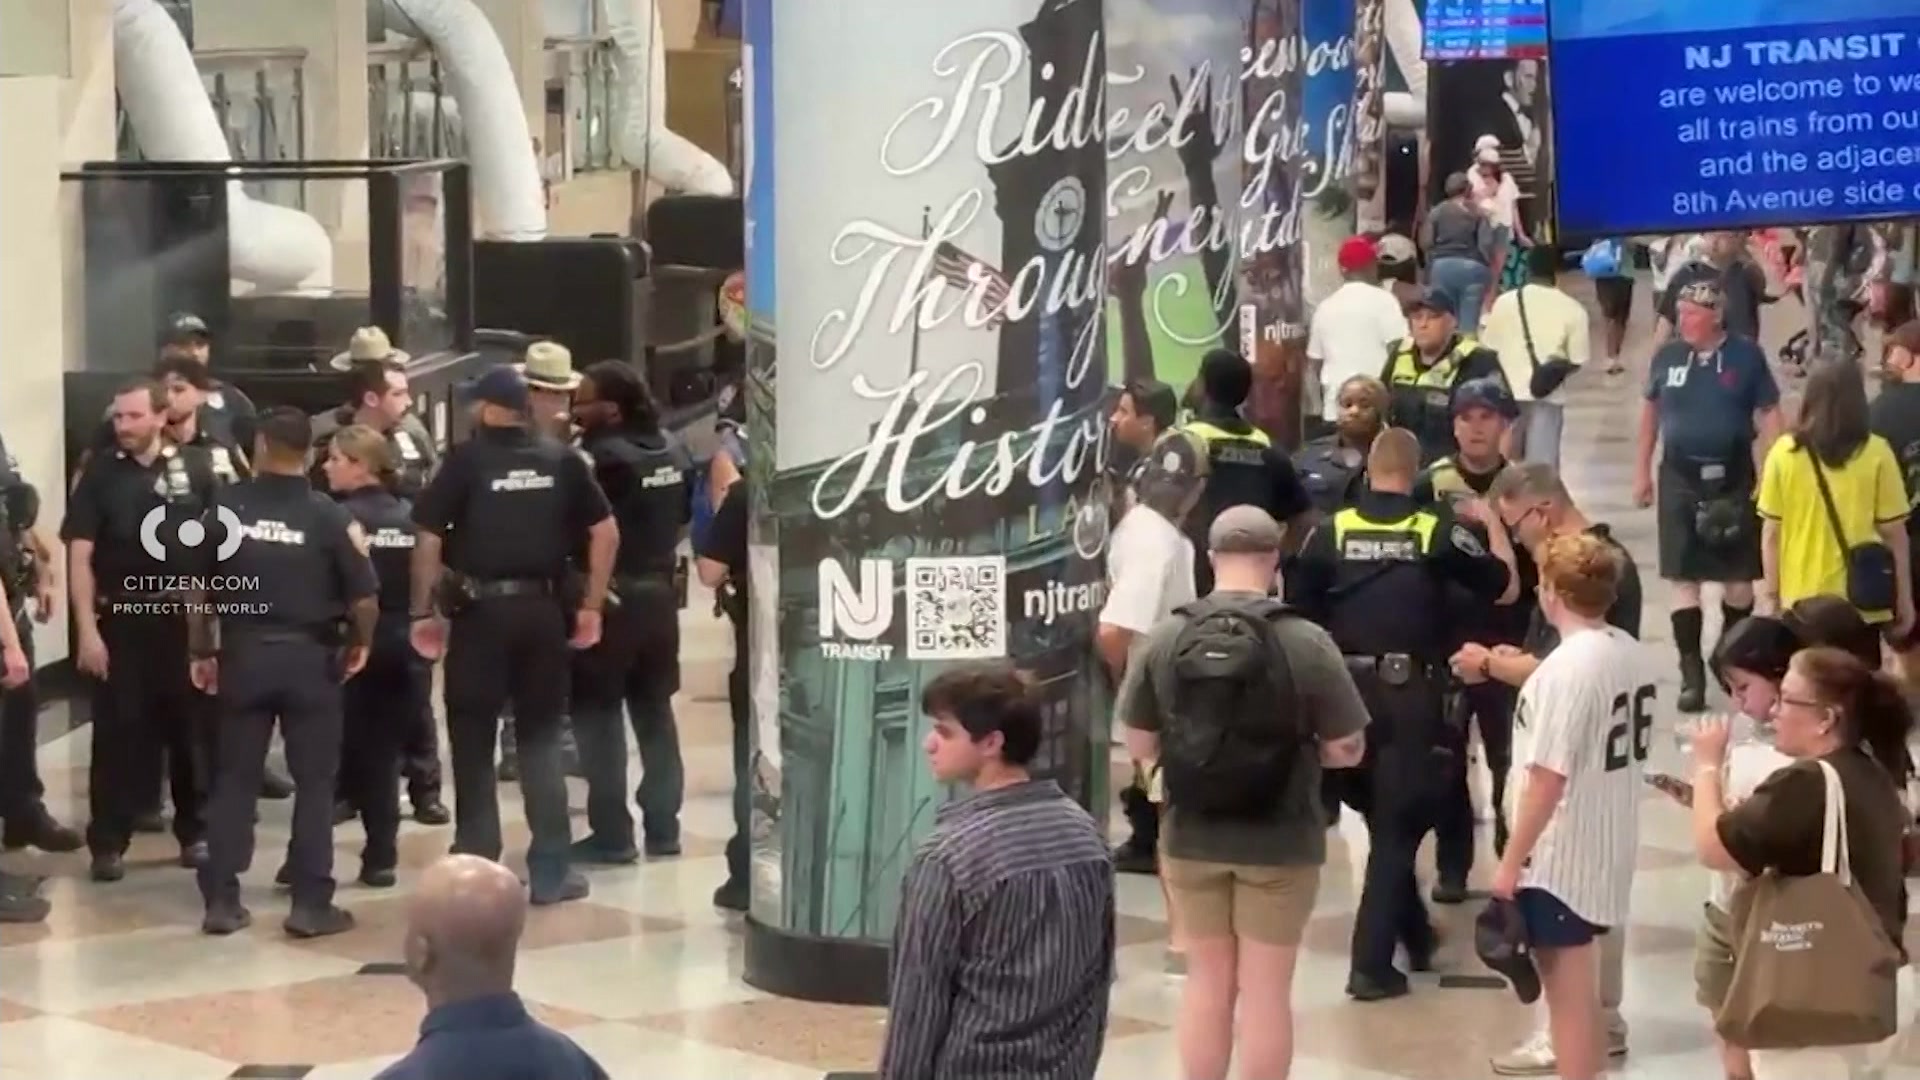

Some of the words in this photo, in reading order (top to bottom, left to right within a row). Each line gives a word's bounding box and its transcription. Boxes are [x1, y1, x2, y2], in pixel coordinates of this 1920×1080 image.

[1684, 45, 1732, 70] NJ
[1743, 32, 1905, 66] TRANSIT
[1105, 58, 1210, 159] eel
[1658, 85, 1706, 109] are
[1713, 77, 1843, 104] welcome
[1853, 72, 1881, 95] to
[1677, 117, 1710, 142] all
[1718, 115, 1798, 140] trains
[1808, 109, 1873, 134] from
[1699, 151, 1753, 178] and
[1761, 150, 1808, 173] the
[1672, 190, 1718, 215] 8th
[1724, 187, 1834, 212] Avenue
[1844, 179, 1905, 205] side
[811, 361, 1108, 560] Histor
[818, 556, 894, 640] NJ
[819, 642, 894, 663] TRANSIT
[1604, 683, 1657, 773] 26
